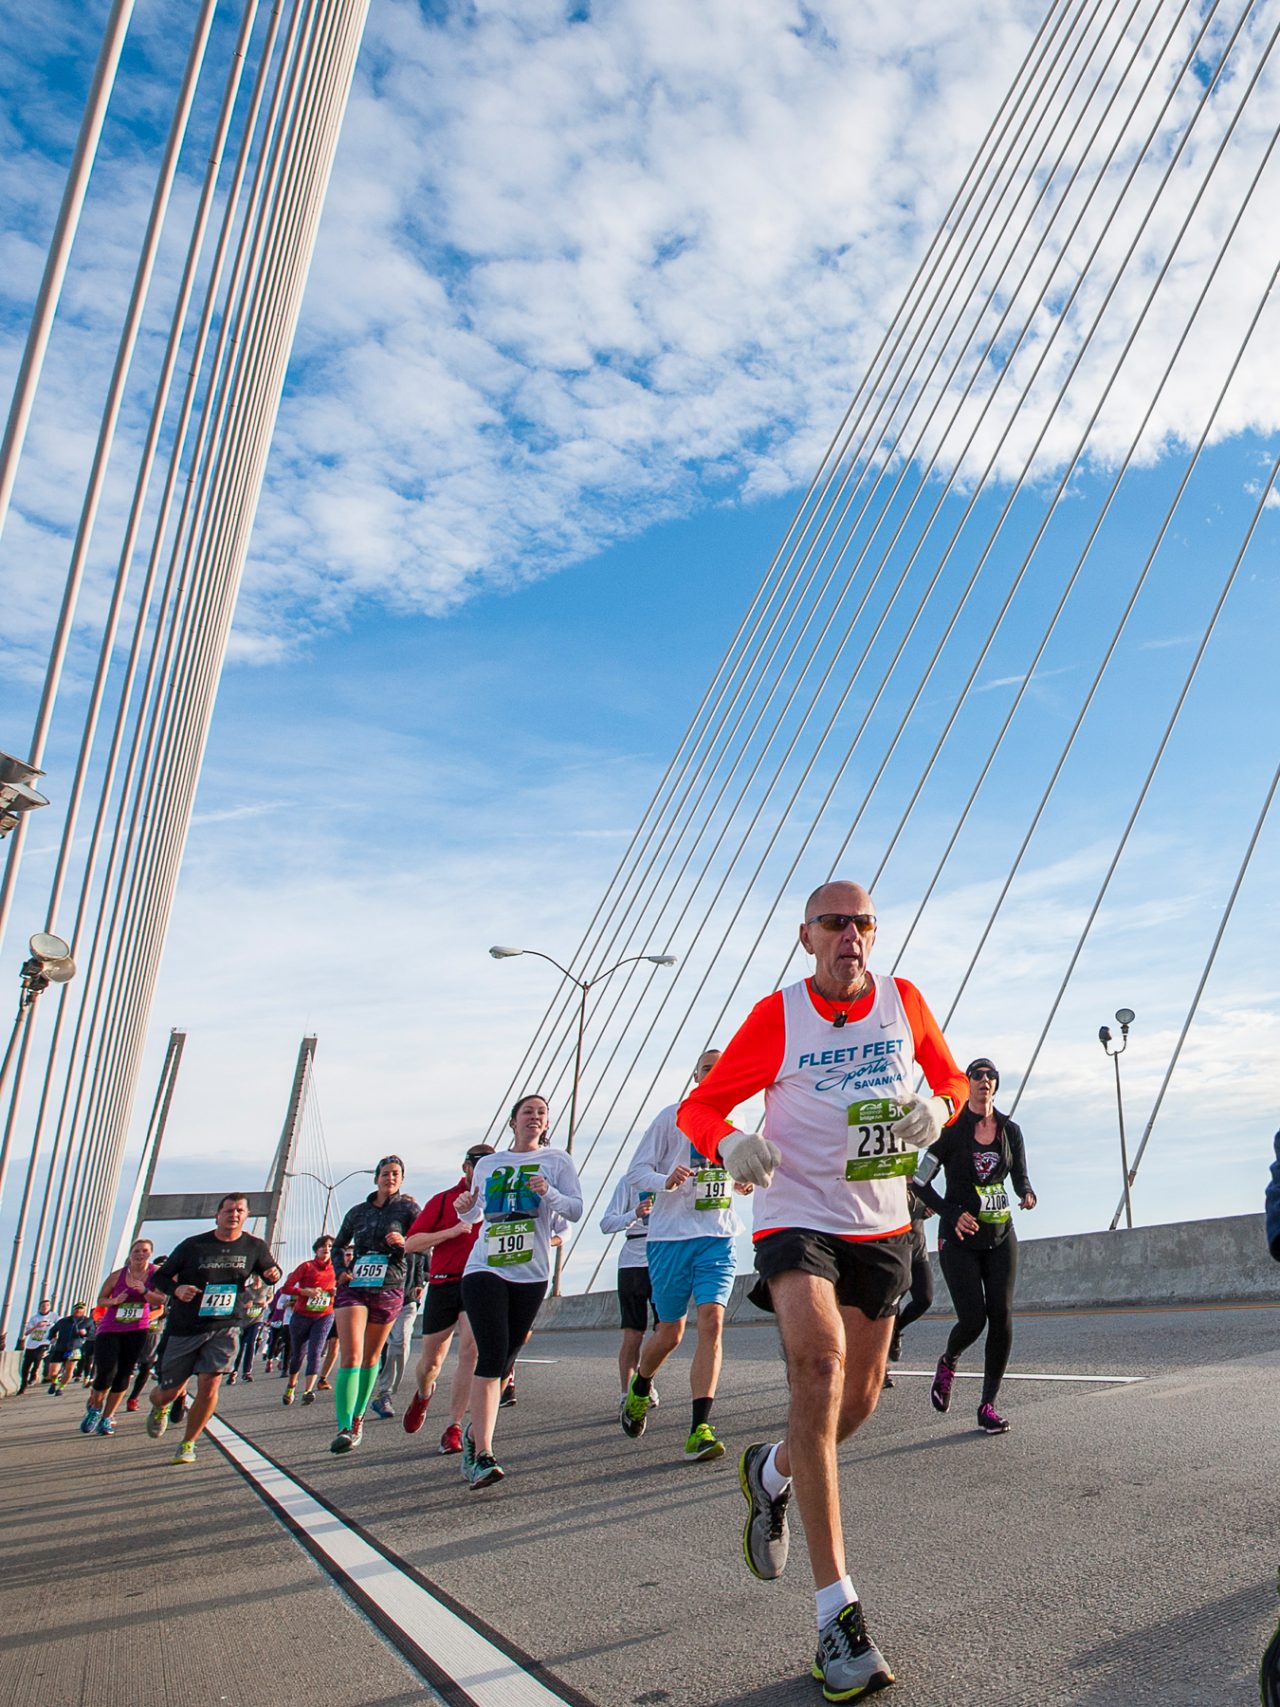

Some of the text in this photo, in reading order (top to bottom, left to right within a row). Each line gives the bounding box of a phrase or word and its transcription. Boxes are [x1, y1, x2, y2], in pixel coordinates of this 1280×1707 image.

[798, 1039, 903, 1069] FLEET FEET
[815, 1057, 896, 1091] Sports
[888, 1103, 905, 1118] 5K
[705, 1182, 726, 1198] 191
[514, 1223, 528, 1233] 5K
[498, 1234, 524, 1254] 190
[356, 1264, 384, 1277] 4505
[206, 1294, 232, 1307] 4713
[122, 1308, 137, 1317] 391
